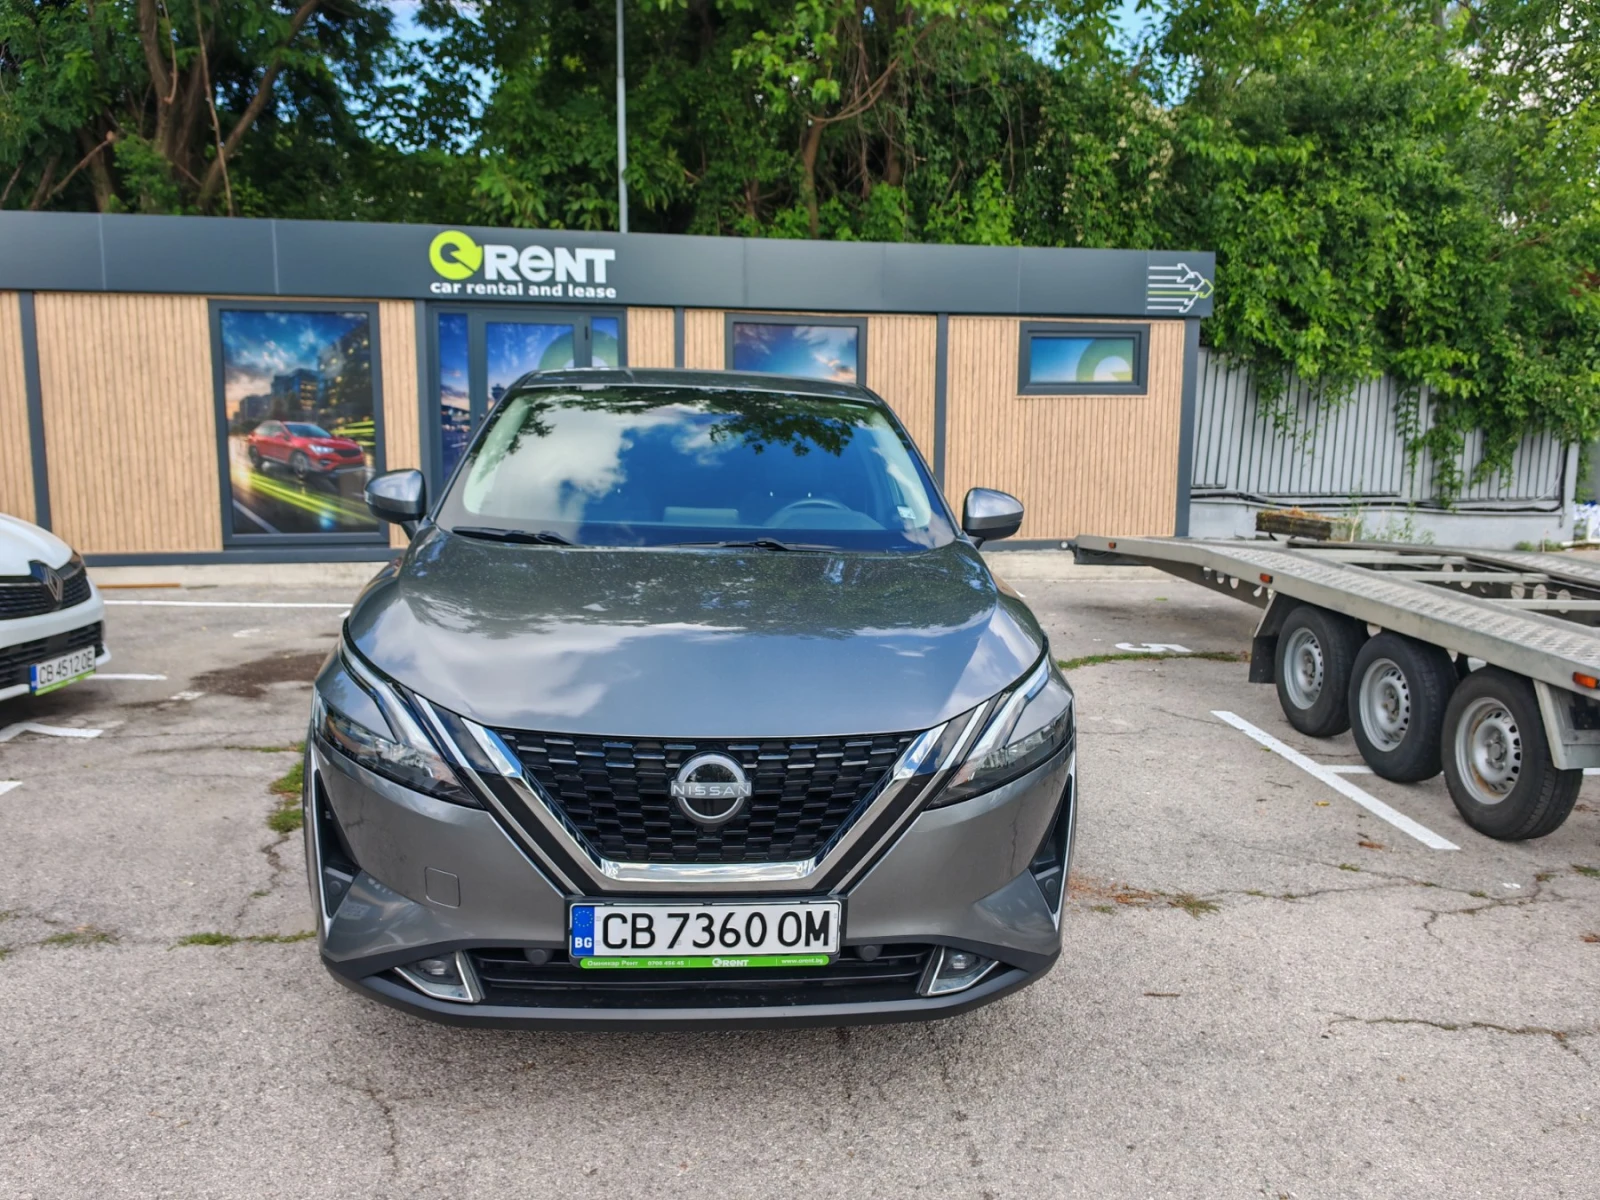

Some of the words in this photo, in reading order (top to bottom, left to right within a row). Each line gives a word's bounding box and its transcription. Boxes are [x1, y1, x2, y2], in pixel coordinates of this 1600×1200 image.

[430, 282, 461, 294] car
[466, 282, 524, 296] rental
[528, 283, 562, 297] and
[568, 284, 617, 298] lease
[672, 785, 750, 796] NISSAN
[574, 937, 593, 948] BG
